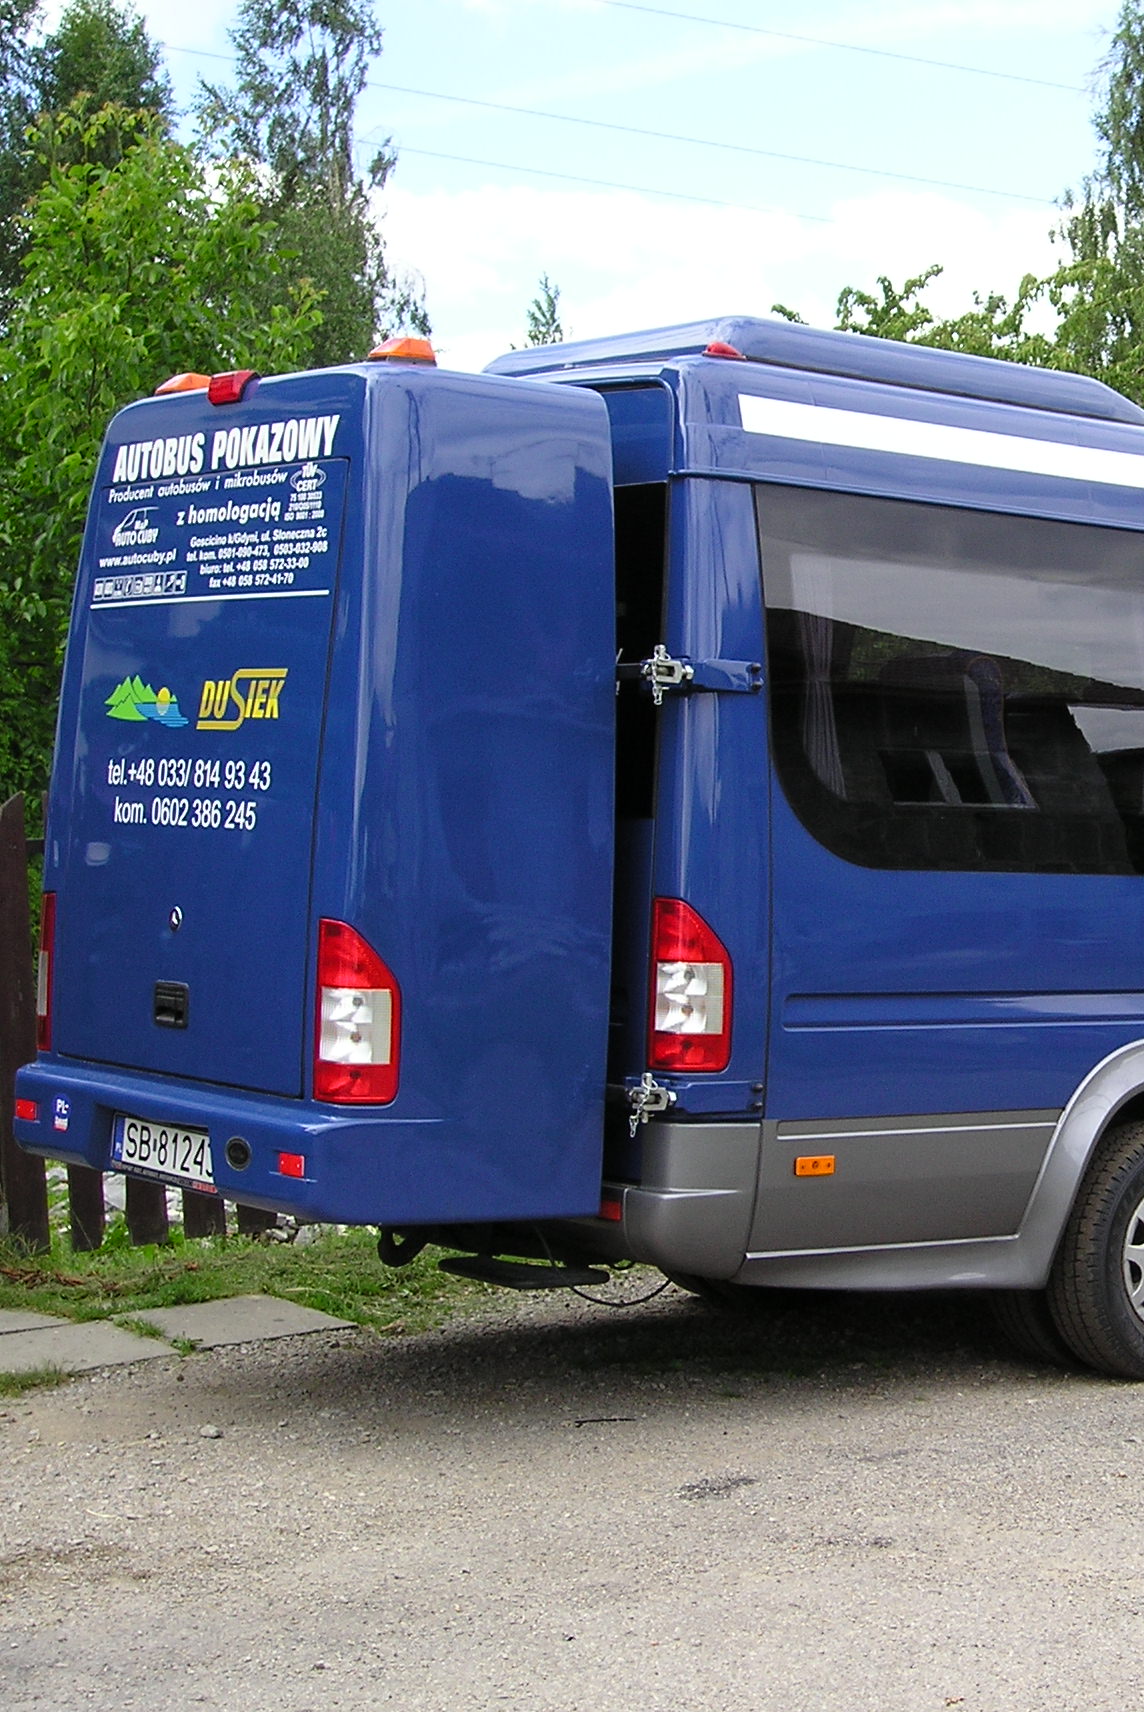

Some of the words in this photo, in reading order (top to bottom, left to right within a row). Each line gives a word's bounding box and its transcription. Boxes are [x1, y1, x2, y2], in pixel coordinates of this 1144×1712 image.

[113, 433, 205, 482] AUTOBUS
[211, 415, 340, 470] POKAZOWY
[108, 484, 154, 504] Producent
[158, 477, 211, 497] autobusów
[215, 475, 220, 490] i
[224, 470, 288, 489] mikrobusów
[296, 478, 318, 492] CERT
[176, 511, 185, 526] z
[187, 497, 281, 527] homologacją
[316, 526, 328, 538] 2c
[99, 548, 177, 568] www.autocuby.pl
[200, 564, 221, 575] biuro:
[209, 577, 221, 588] fax
[196, 668, 288, 730] DUSIEK
[107, 758, 155, 786] tel.+48
[158, 758, 192, 787] 033/
[194, 759, 221, 788] 814
[224, 761, 245, 790] 93
[249, 761, 271, 791] 43
[114, 796, 147, 824] kom.
[151, 797, 189, 827] 0602
[191, 799, 221, 828] 386
[224, 801, 256, 831] 245
[126, 1122, 151, 1162] SB
